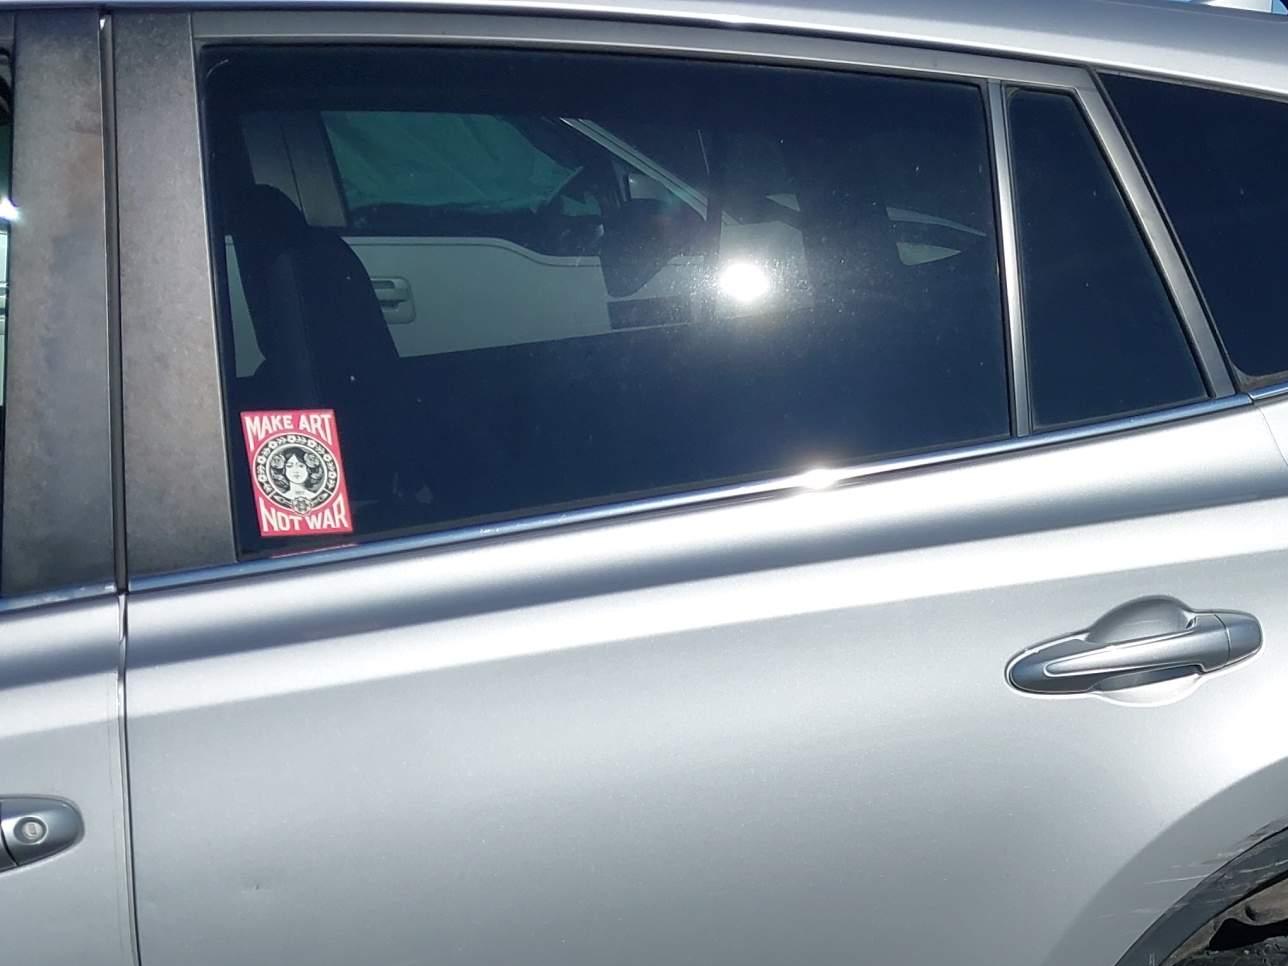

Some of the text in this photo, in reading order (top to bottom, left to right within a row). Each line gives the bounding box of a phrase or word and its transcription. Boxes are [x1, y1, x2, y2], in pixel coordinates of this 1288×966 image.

[244, 413, 333, 452] MAKE ART
[258, 492, 349, 533] NOT WAR
